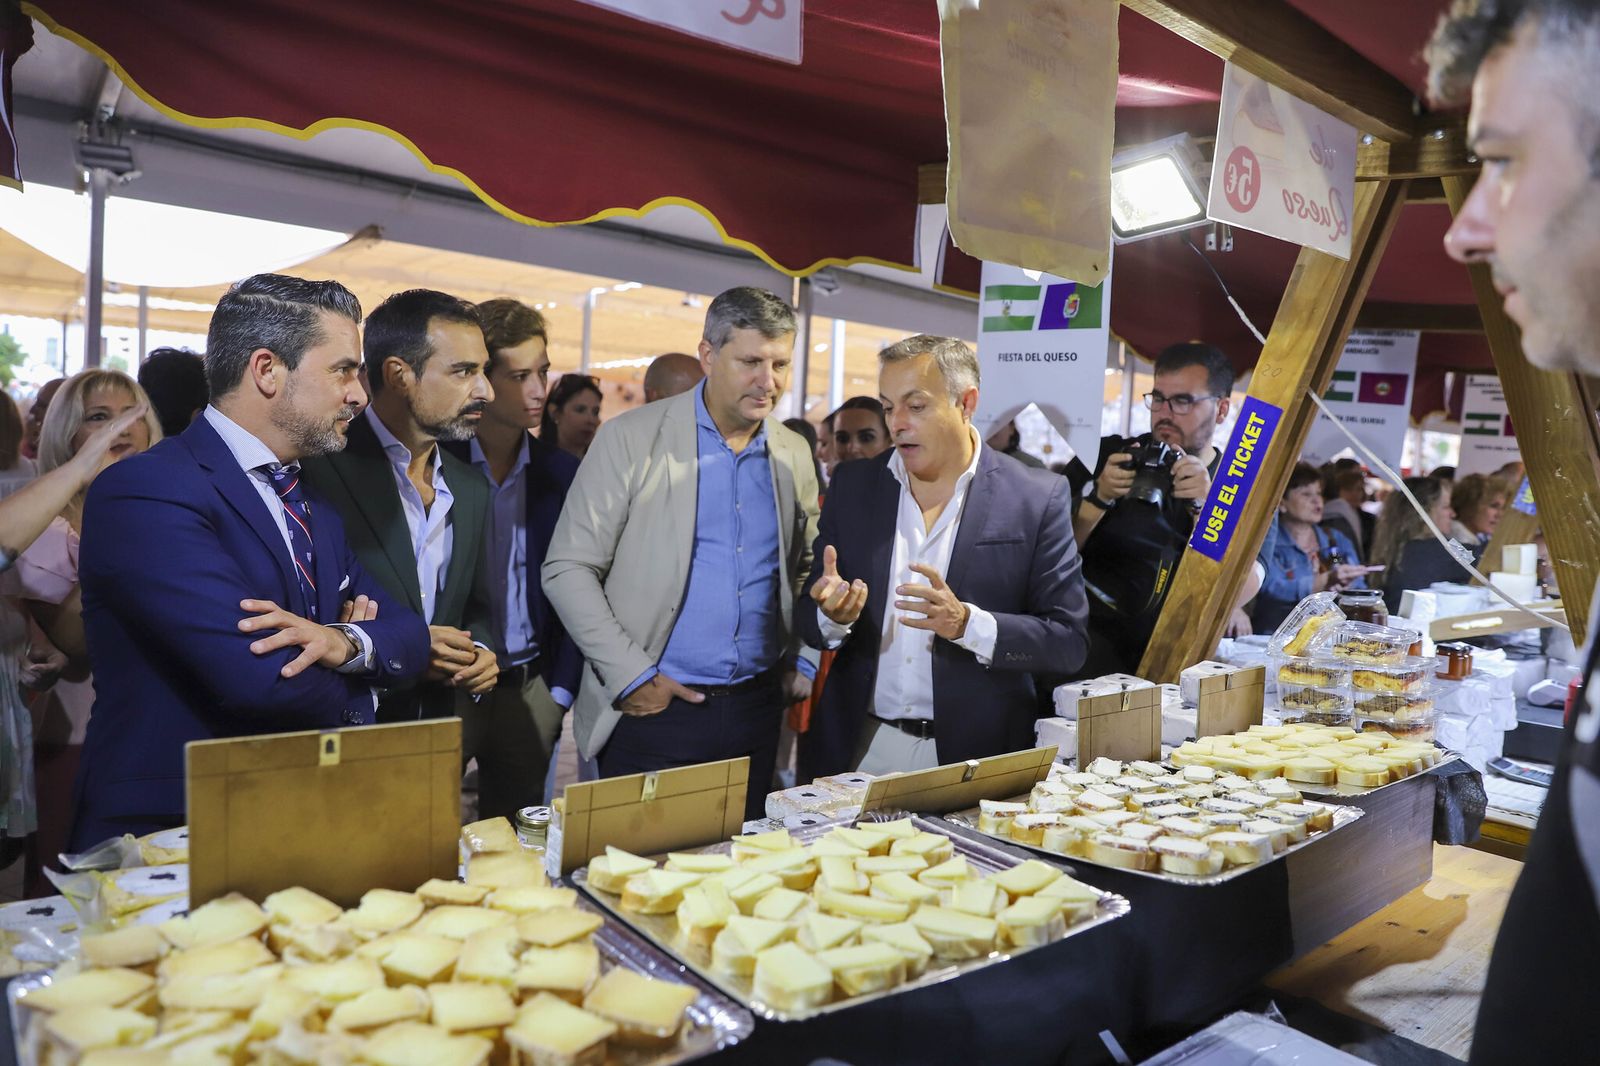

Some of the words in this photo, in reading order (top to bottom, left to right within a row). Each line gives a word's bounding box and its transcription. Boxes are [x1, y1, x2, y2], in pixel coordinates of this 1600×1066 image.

[998, 352, 1023, 362] FIESTA
[1025, 352, 1042, 362] DEL
[1043, 352, 1078, 362] QUESO
[1227, 411, 1266, 478] TICKET
[1217, 484, 1239, 506] EL
[1202, 505, 1229, 543] USE
